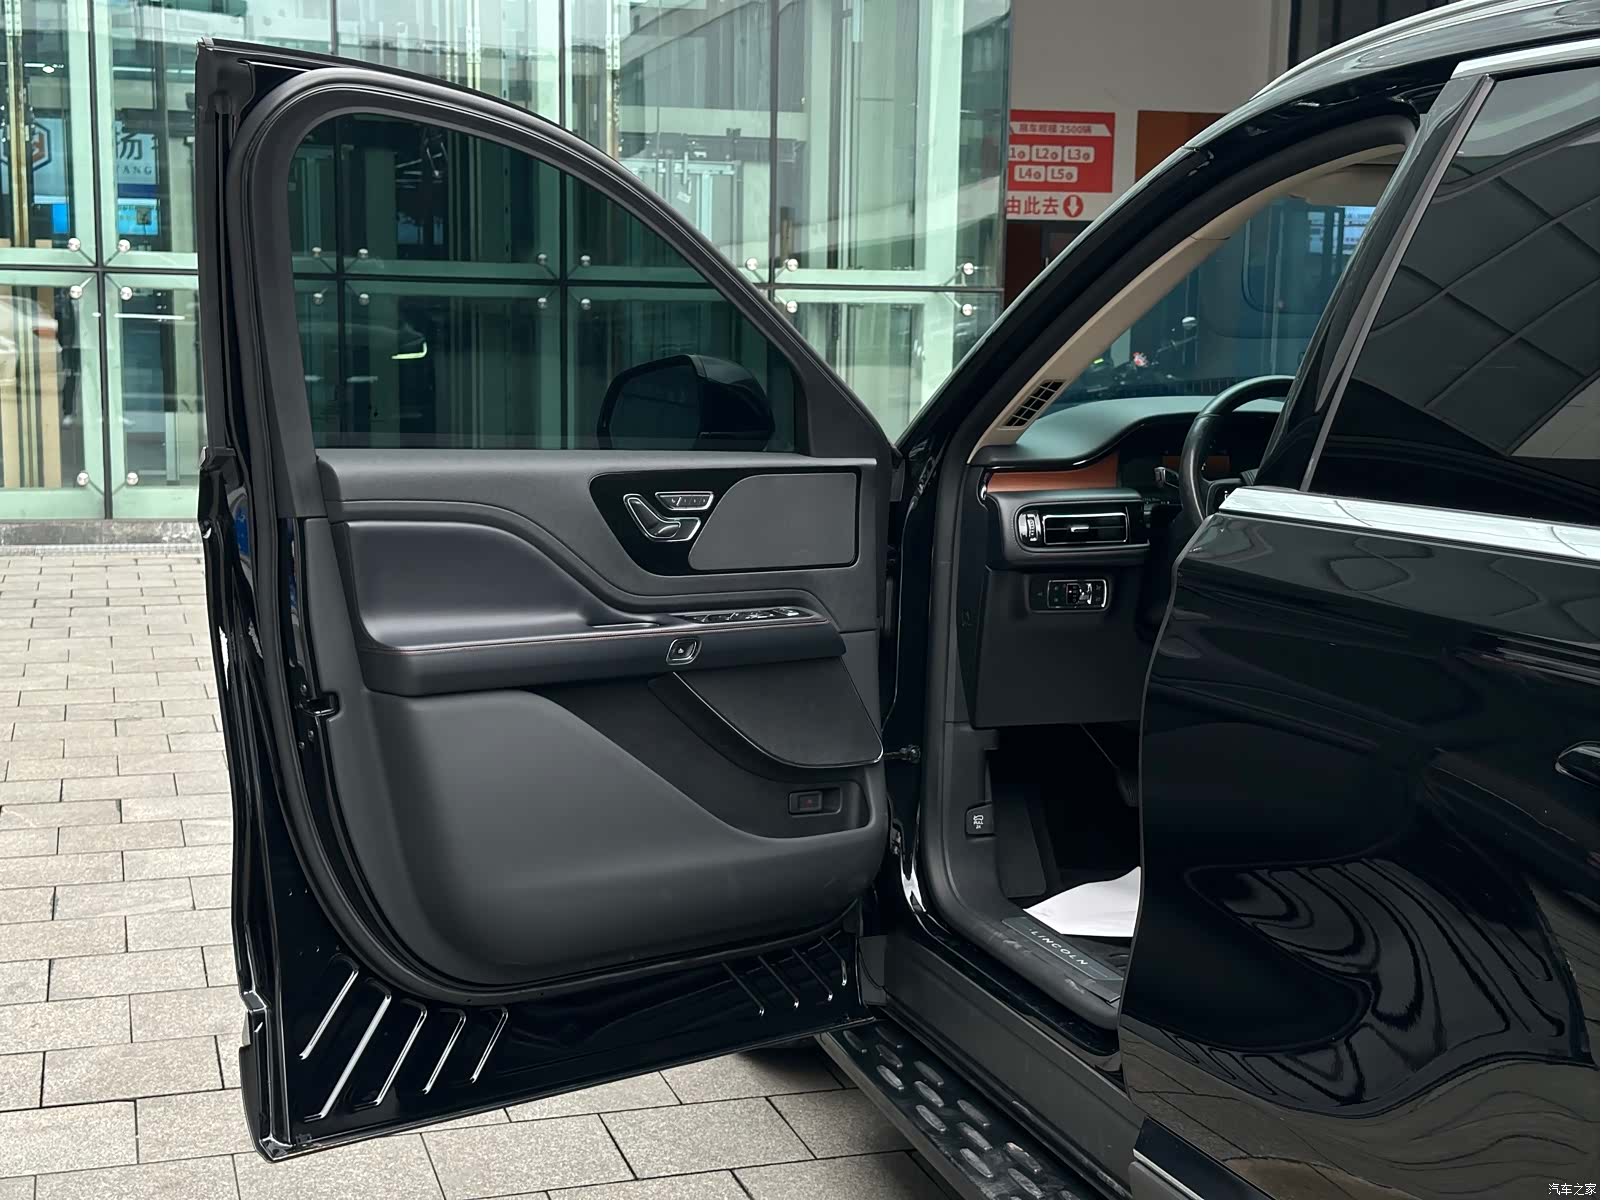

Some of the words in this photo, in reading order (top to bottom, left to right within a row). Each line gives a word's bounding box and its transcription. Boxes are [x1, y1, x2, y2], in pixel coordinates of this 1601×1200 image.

[117, 165, 152, 175] ANG
[1007, 195, 1059, 215] 由此去
[1031, 930, 1088, 965] LINCOLN
